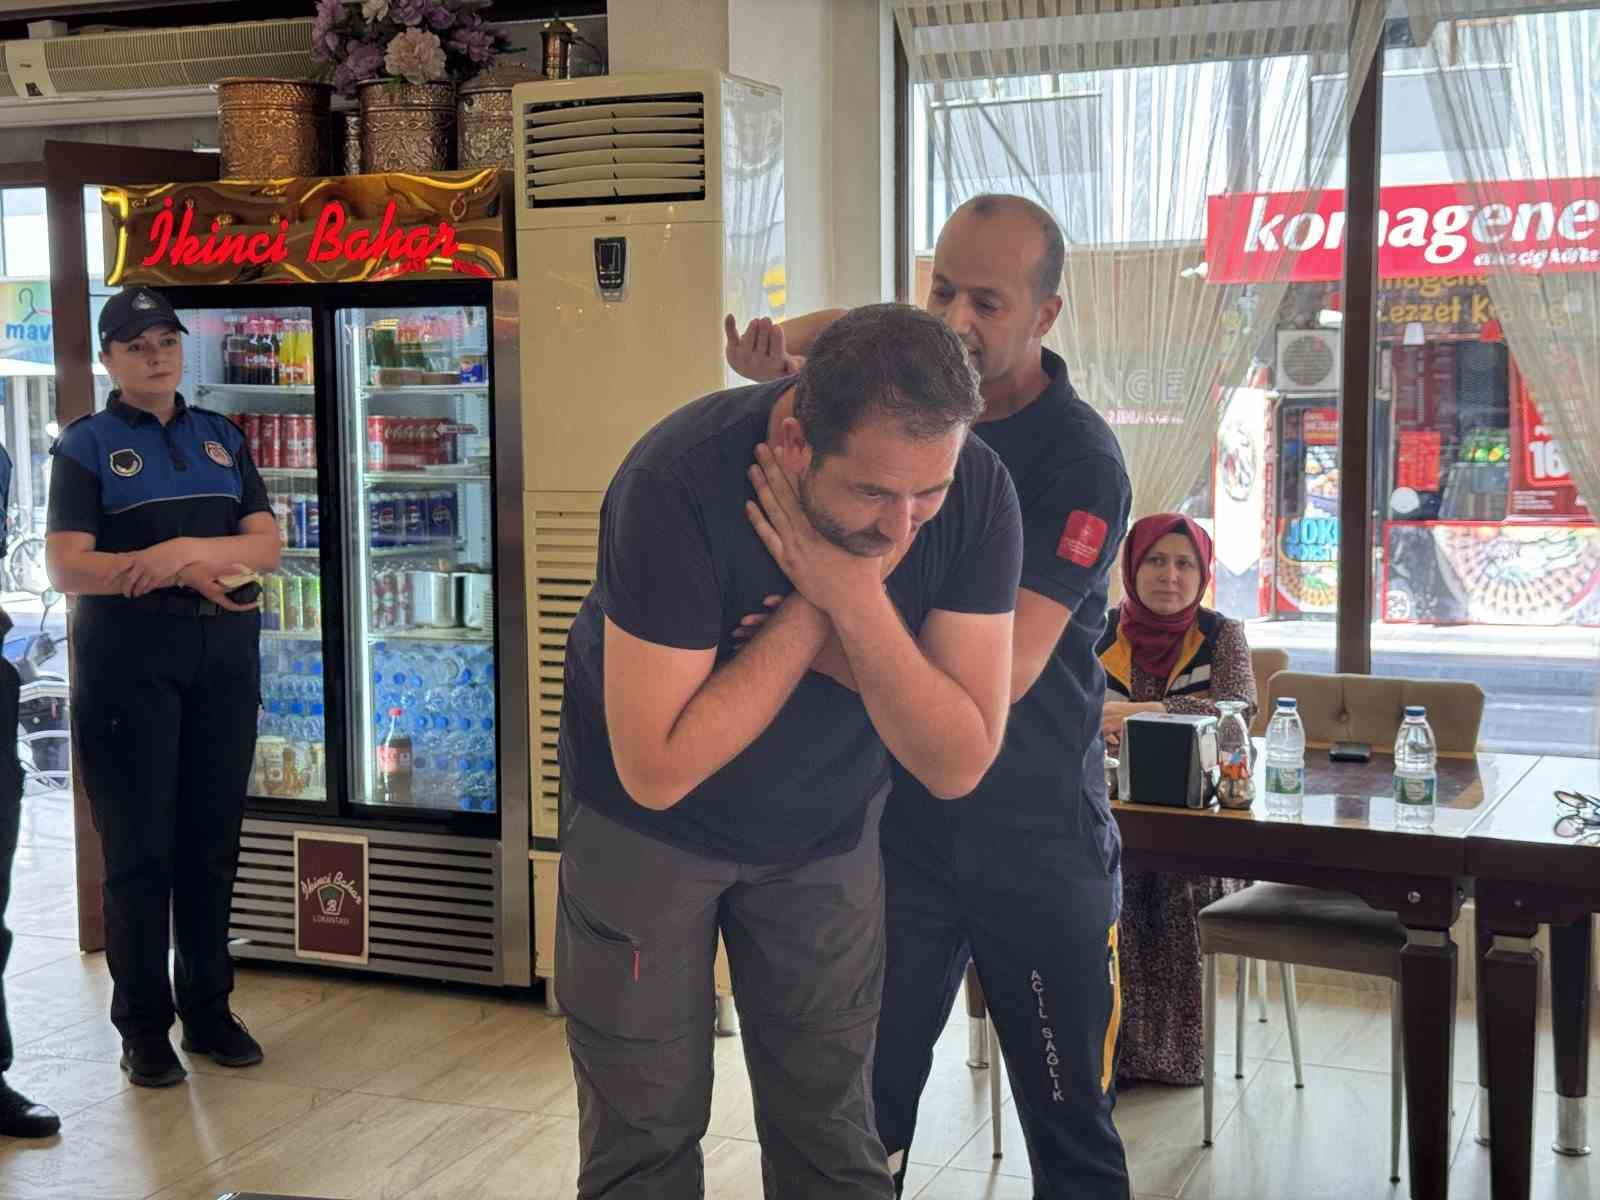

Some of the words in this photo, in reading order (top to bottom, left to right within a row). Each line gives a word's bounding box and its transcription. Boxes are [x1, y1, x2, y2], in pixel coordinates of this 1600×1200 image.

[143, 196, 289, 266] İkinci
[306, 200, 459, 263] Bahar
[6, 323, 51, 341] mav
